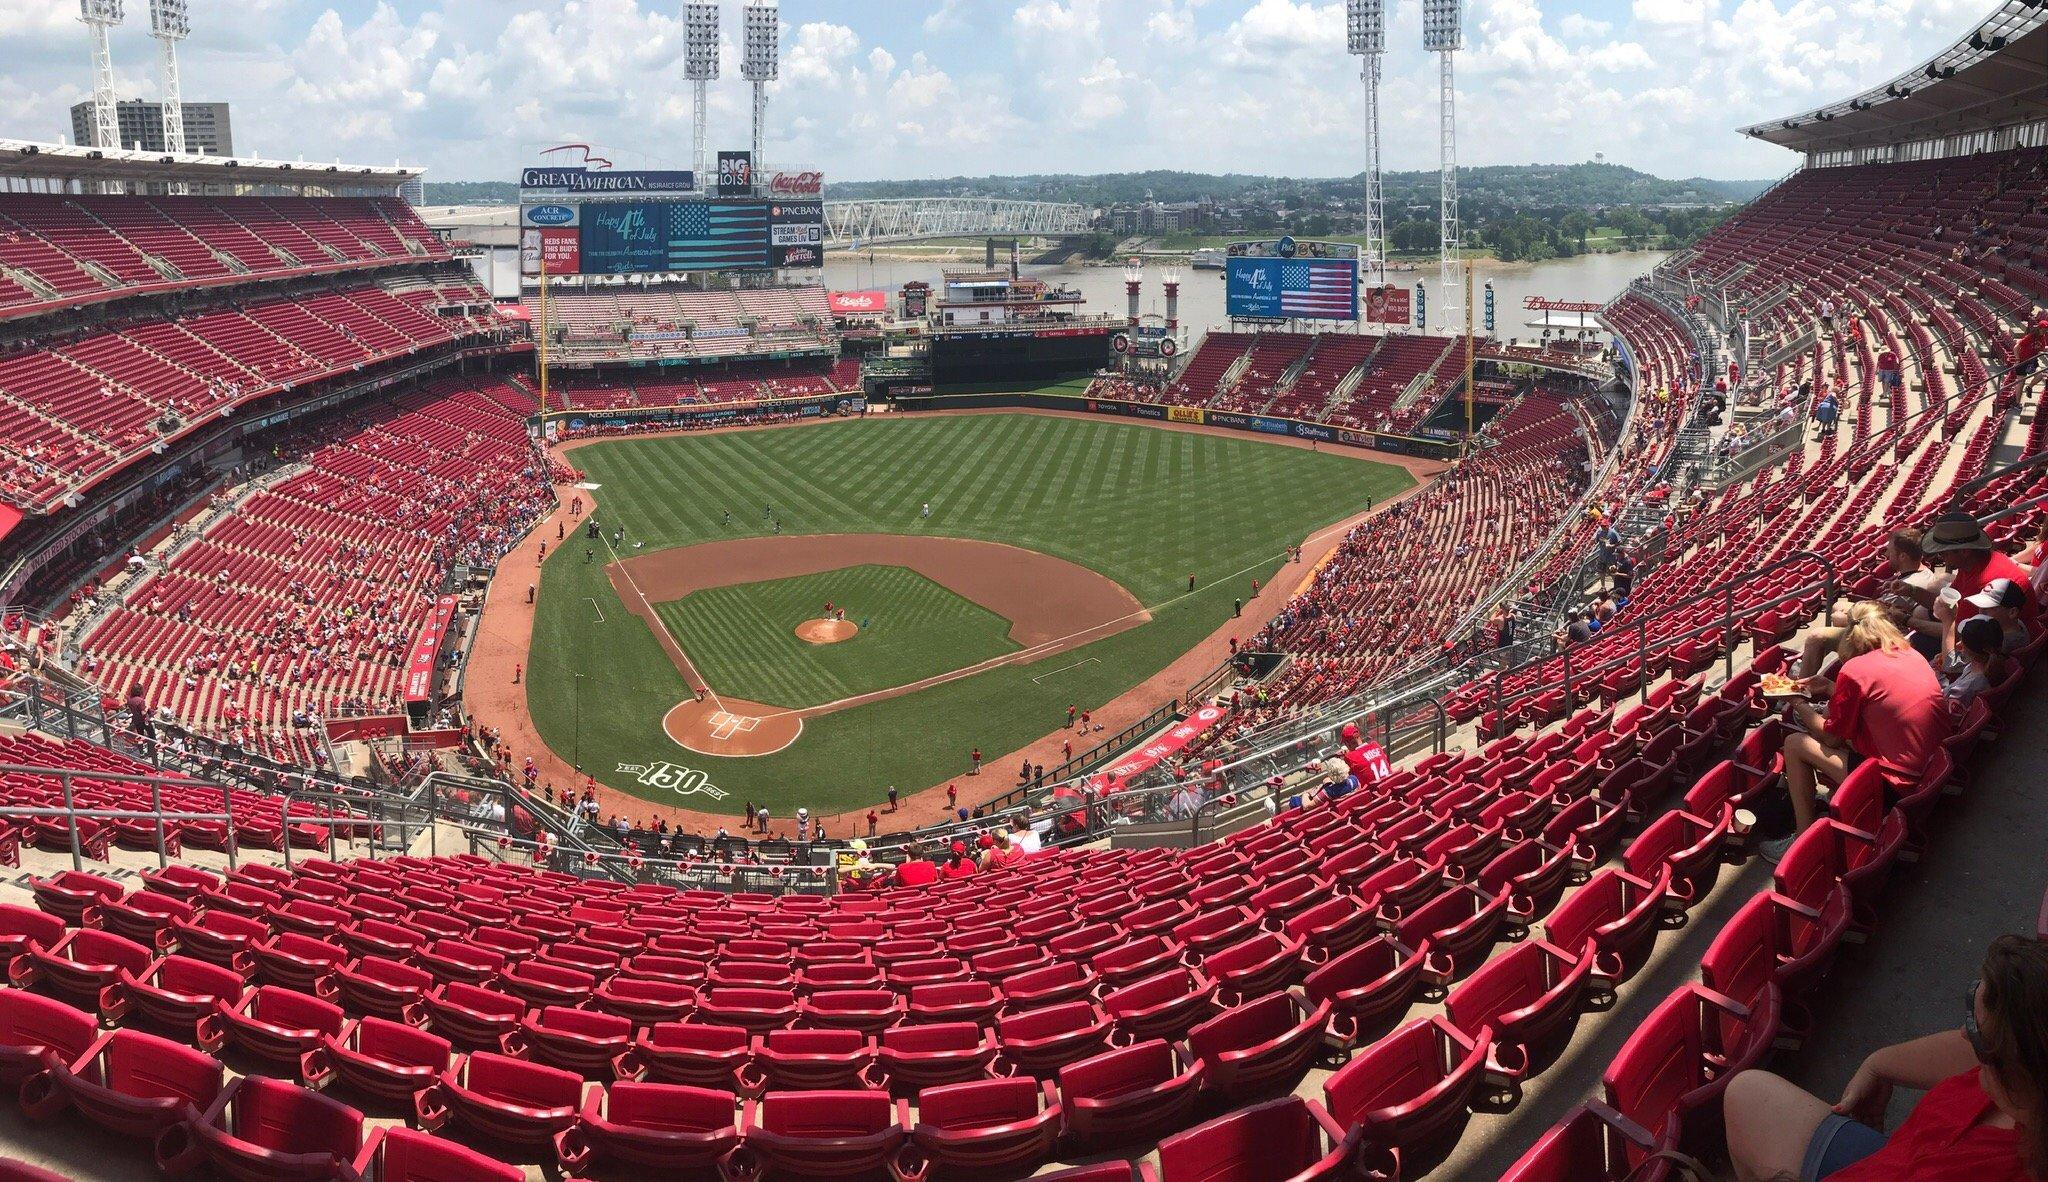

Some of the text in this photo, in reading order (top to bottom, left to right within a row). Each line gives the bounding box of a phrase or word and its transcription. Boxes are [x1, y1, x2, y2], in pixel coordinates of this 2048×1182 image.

[721, 159, 749, 174] BIG
[523, 169, 580, 186] GREAT
[573, 175, 646, 190] AMERICAN
[771, 172, 824, 194] Coca-Cola
[637, 227, 658, 242] July
[773, 226, 796, 236] STREAM
[561, 238, 578, 246] FANS,
[778, 235, 798, 243] GAMES
[544, 245, 559, 253] THIS
[836, 296, 873, 308] Reds
[1523, 296, 1603, 312] Budweiser
[1137, 408, 1161, 417] Fanatics
[1304, 426, 1330, 438] Staffmark
[64, 514, 99, 550] STOCKINGS
[637, 760, 709, 795] 150
[1370, 759, 1390, 781] 14
